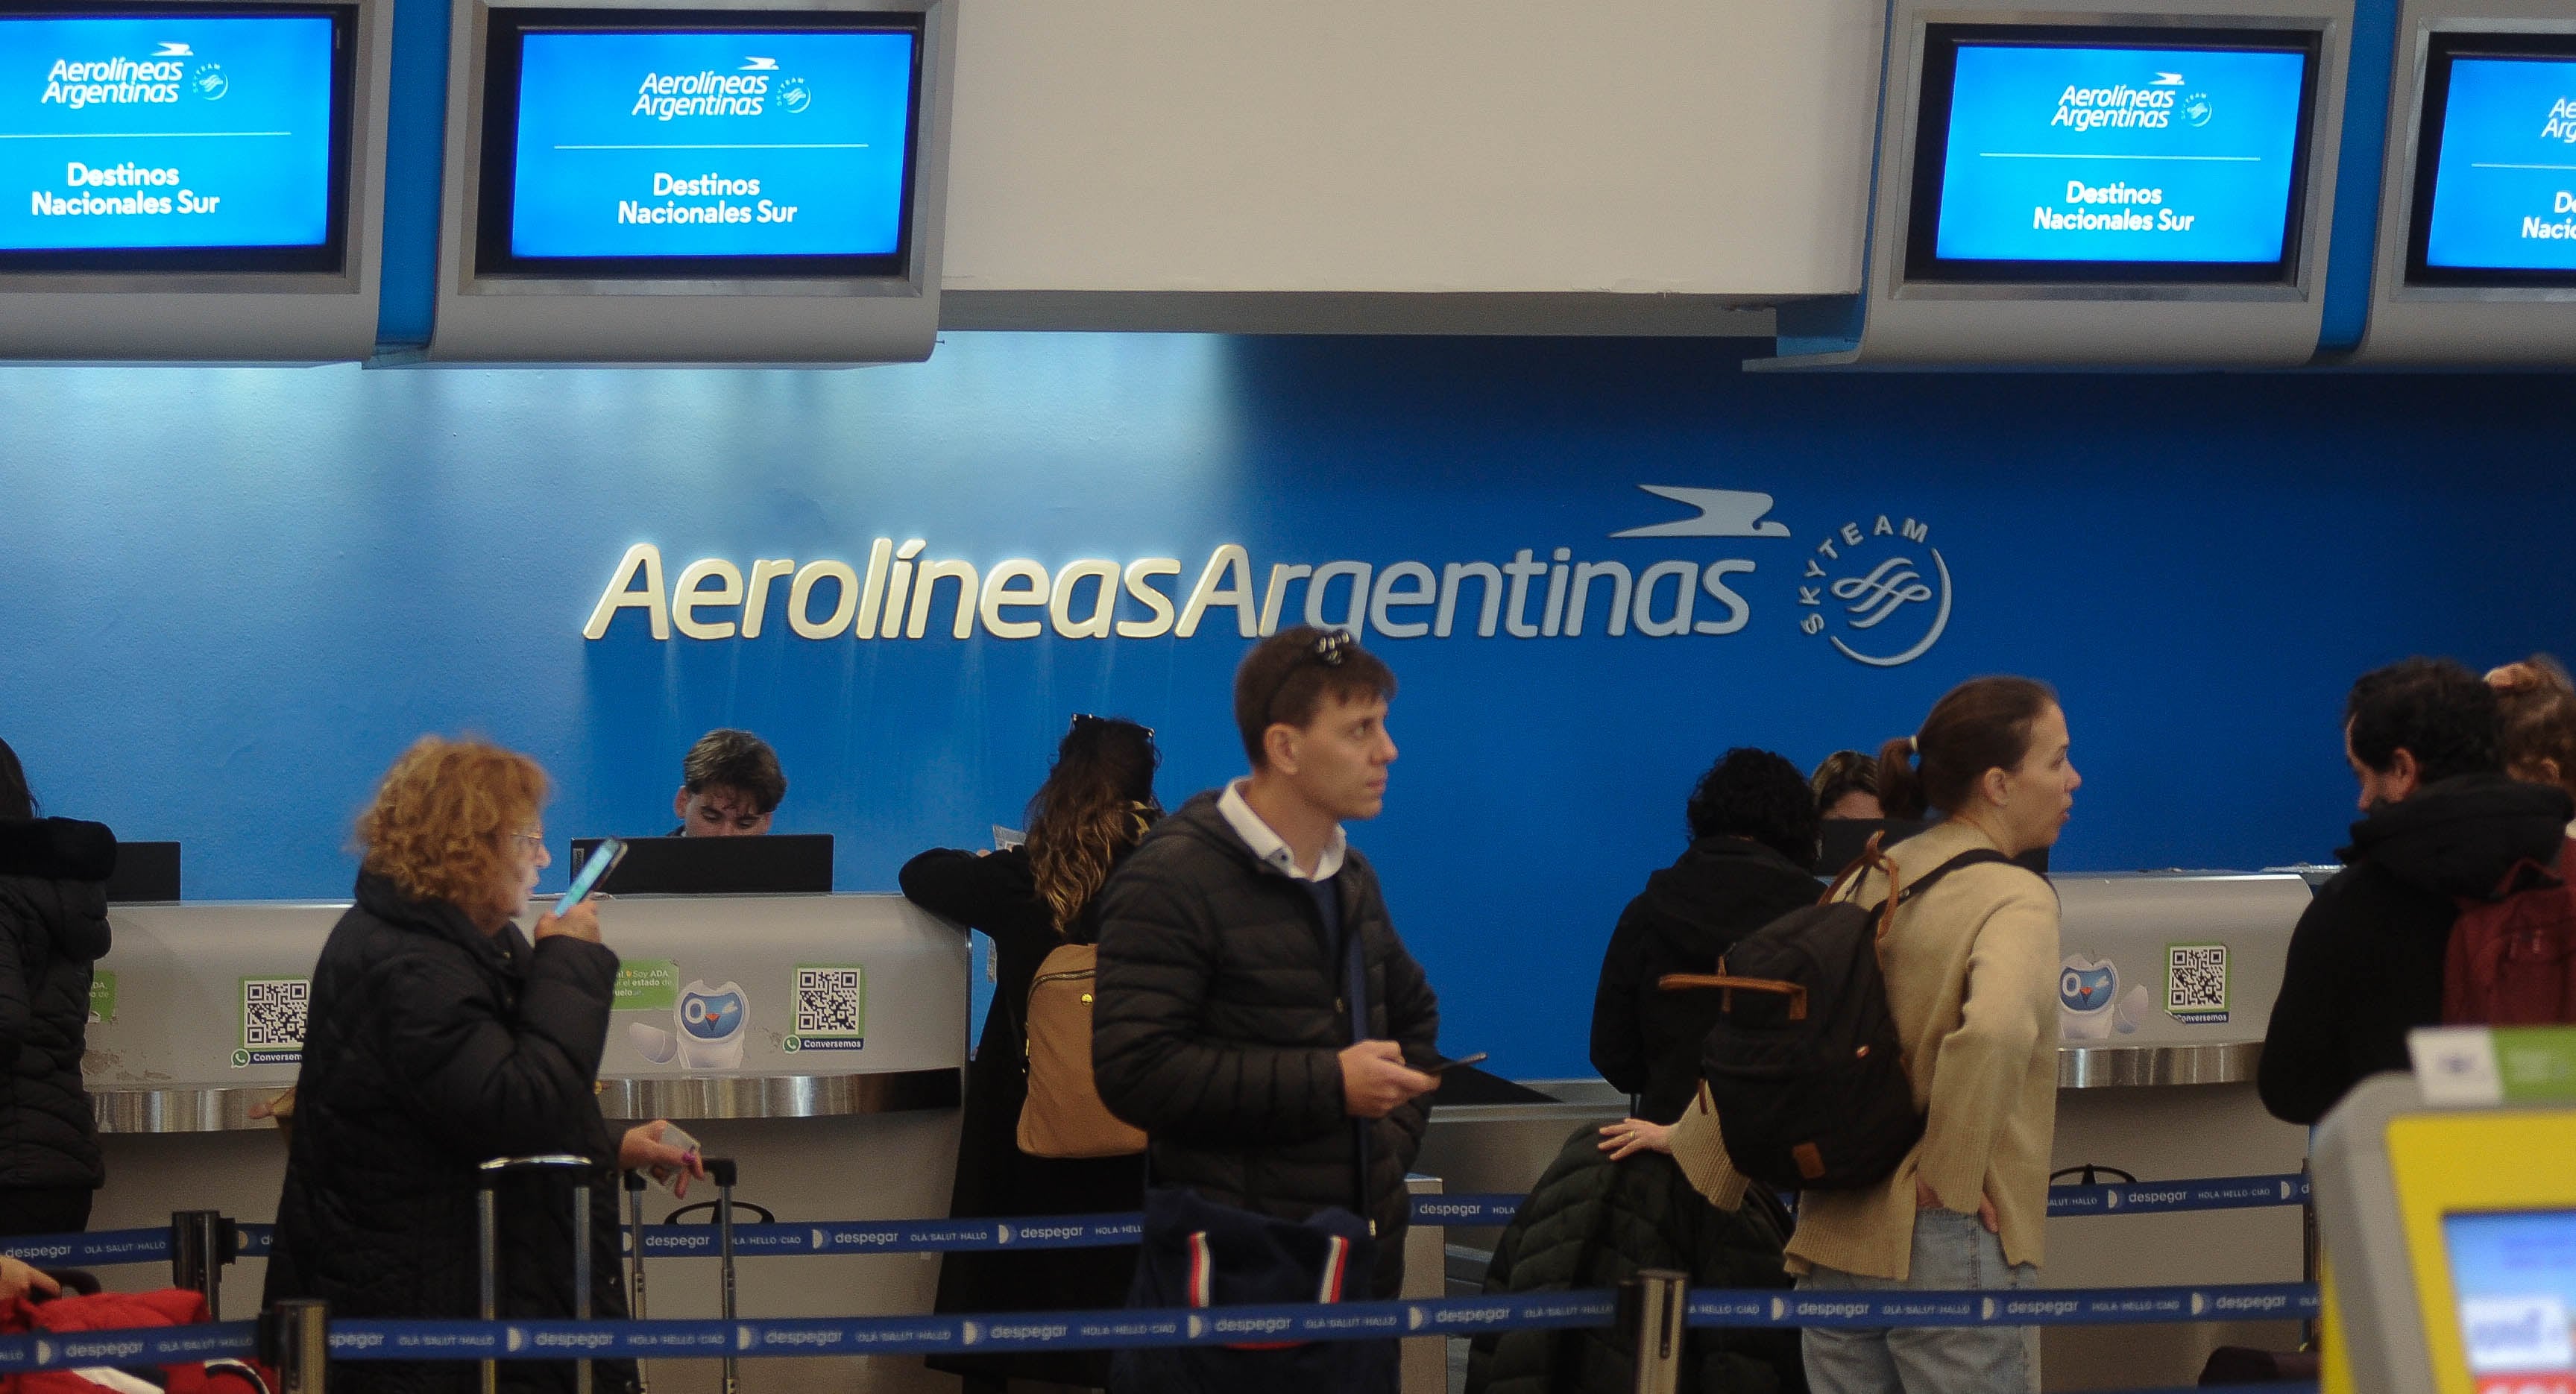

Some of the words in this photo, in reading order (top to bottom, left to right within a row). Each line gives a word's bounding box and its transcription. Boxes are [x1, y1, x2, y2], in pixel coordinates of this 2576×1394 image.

[48, 57, 183, 81] Aerolíneas
[41, 80, 180, 109] Argentinas
[638, 71, 769, 95] Aerolíneas
[632, 93, 764, 121] Argentinas
[2058, 85, 2176, 109] Aerolíneas
[2050, 106, 2170, 132] Argentinas
[66, 162, 180, 188] Destinos
[653, 172, 760, 196] Destinos
[31, 191, 171, 216] Nacionales
[177, 189, 221, 215] Sur
[2066, 180, 2162, 205] Destinos
[617, 201, 752, 224] Nacionales
[757, 200, 798, 223] Sur
[2033, 206, 2154, 232] Nacionales
[2157, 209, 2195, 233] Sur
[2522, 215, 2576, 239] Naci
[1799, 514, 1929, 635] SKYTEAM
[804, 1038, 861, 1049] Conversemos
[2129, 1191, 2188, 1204] despegar
[2198, 1191, 2220, 1199] HOLA
[2223, 1189, 2249, 1198] HELLO
[2252, 1188, 2271, 1196] CIAO
[1420, 1203, 1481, 1217] despegar
[646, 1235, 711, 1248] despegar
[835, 1231, 899, 1244] despegar
[1021, 1226, 1084, 1239] despegar
[5, 1245, 72, 1259] despegar
[1798, 1303, 1870, 1319] despegar
[2007, 1300, 2079, 1316] despegar
[2216, 1296, 2286, 1311] despegar
[535, 1333, 615, 1349] despegar
[764, 1331, 843, 1346] despegar
[990, 1325, 1068, 1341] despegar
[1215, 1317, 1292, 1334] despegar
[1435, 1308, 1511, 1324] despegar
[66, 1342, 145, 1359] despegar
